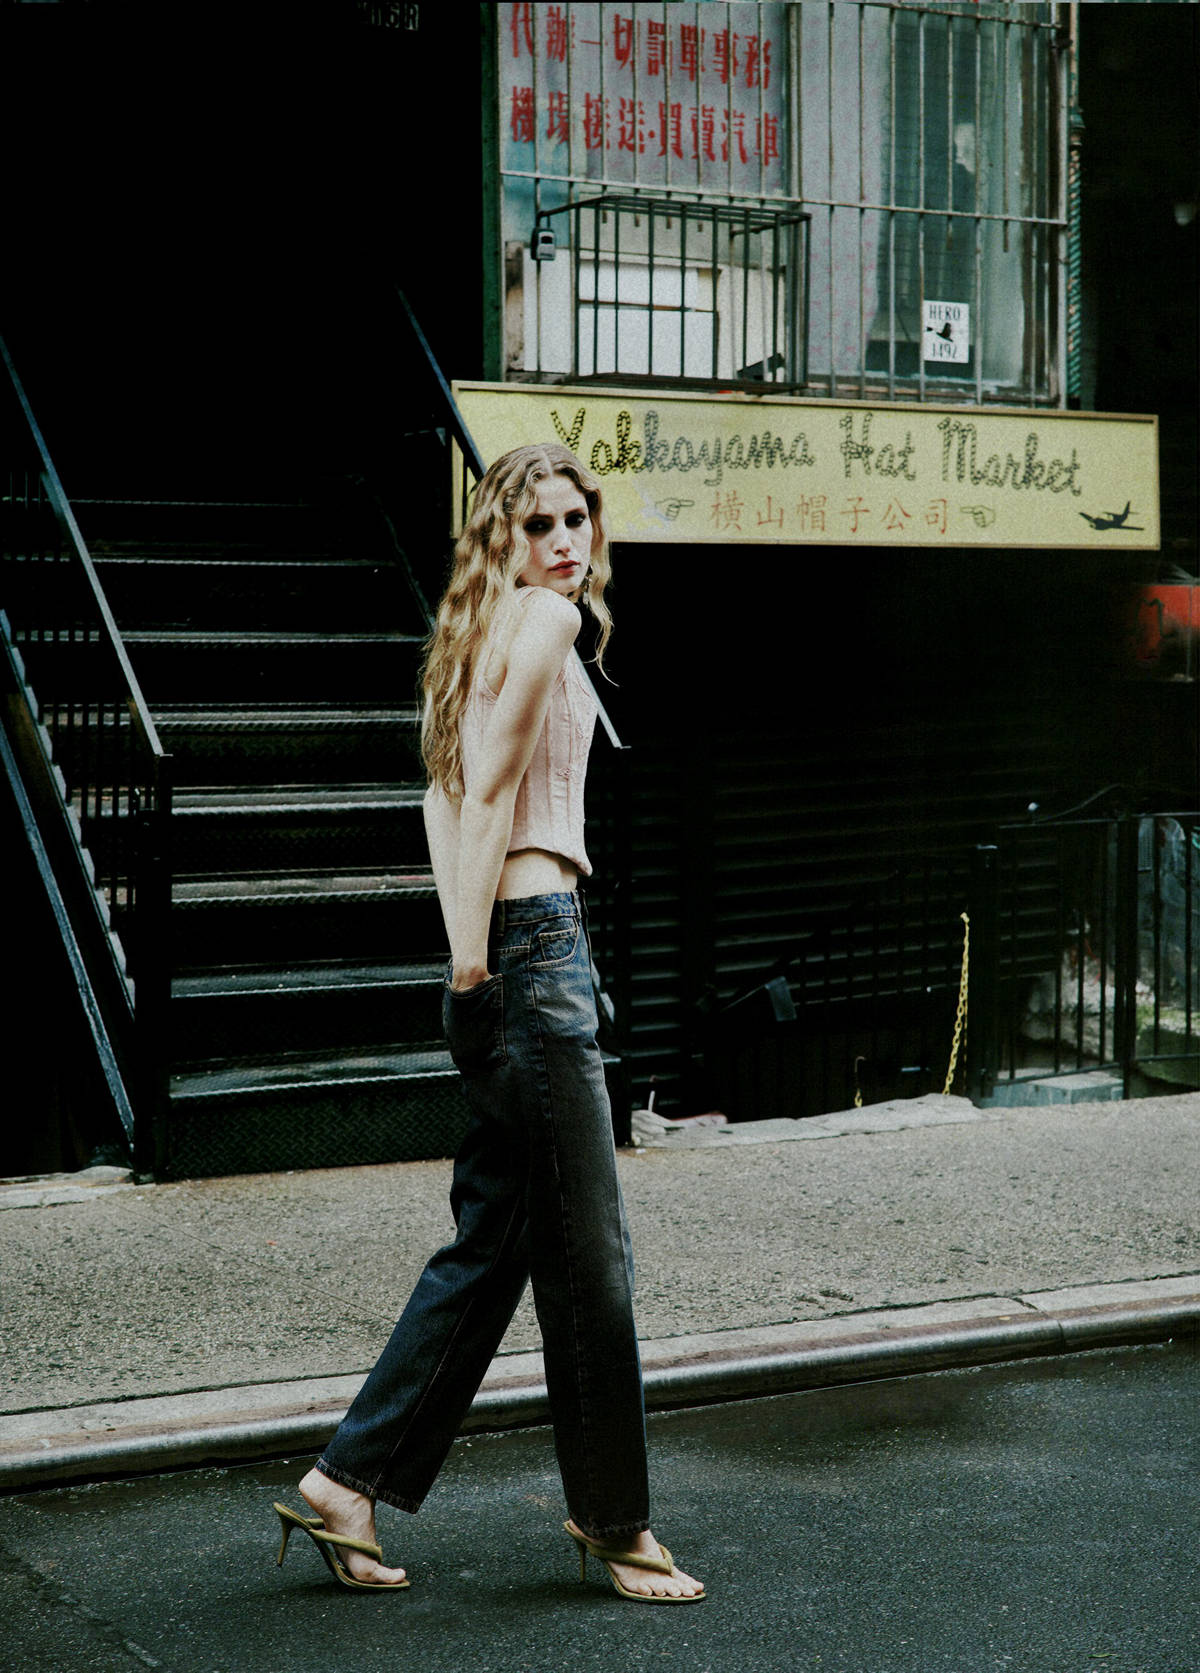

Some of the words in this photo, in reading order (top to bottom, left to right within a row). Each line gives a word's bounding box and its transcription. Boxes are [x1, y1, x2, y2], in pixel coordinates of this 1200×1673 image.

[929, 304, 961, 320] HERO
[839, 411, 916, 481] Hat
[937, 417, 1083, 496] Market
